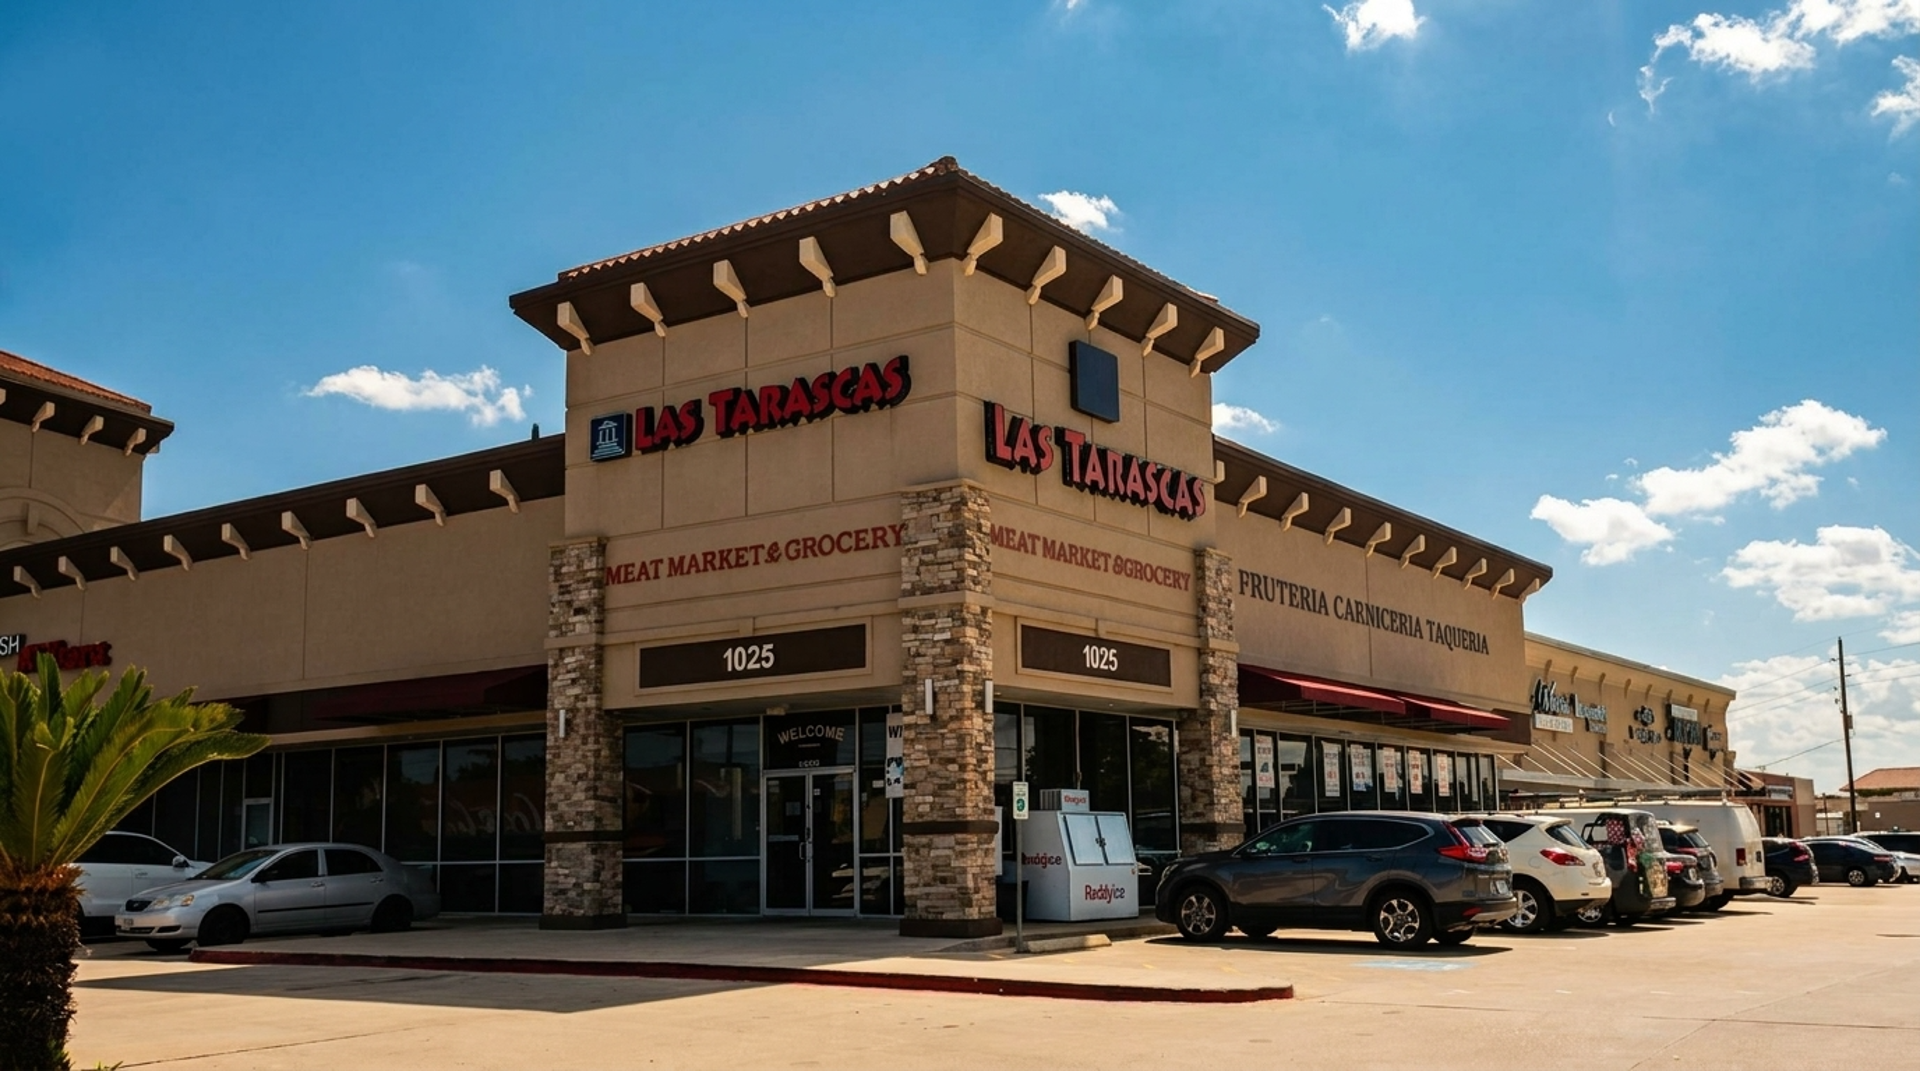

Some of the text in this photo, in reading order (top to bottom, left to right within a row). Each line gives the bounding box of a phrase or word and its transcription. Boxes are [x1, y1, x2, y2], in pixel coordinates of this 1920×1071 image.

[635, 355, 912, 454] LAS TARASCAS
[984, 401, 1205, 521] LAS TARASCAS
[990, 524, 1042, 556] MEAT
[605, 559, 664, 586] MEAT
[1238, 568, 1490, 656] FRUTERIA CARNICERIA TAQUERIA
[722, 643, 776, 673] 1025
[1082, 644, 1119, 672] 1025
[777, 724, 845, 745] WELCOME
